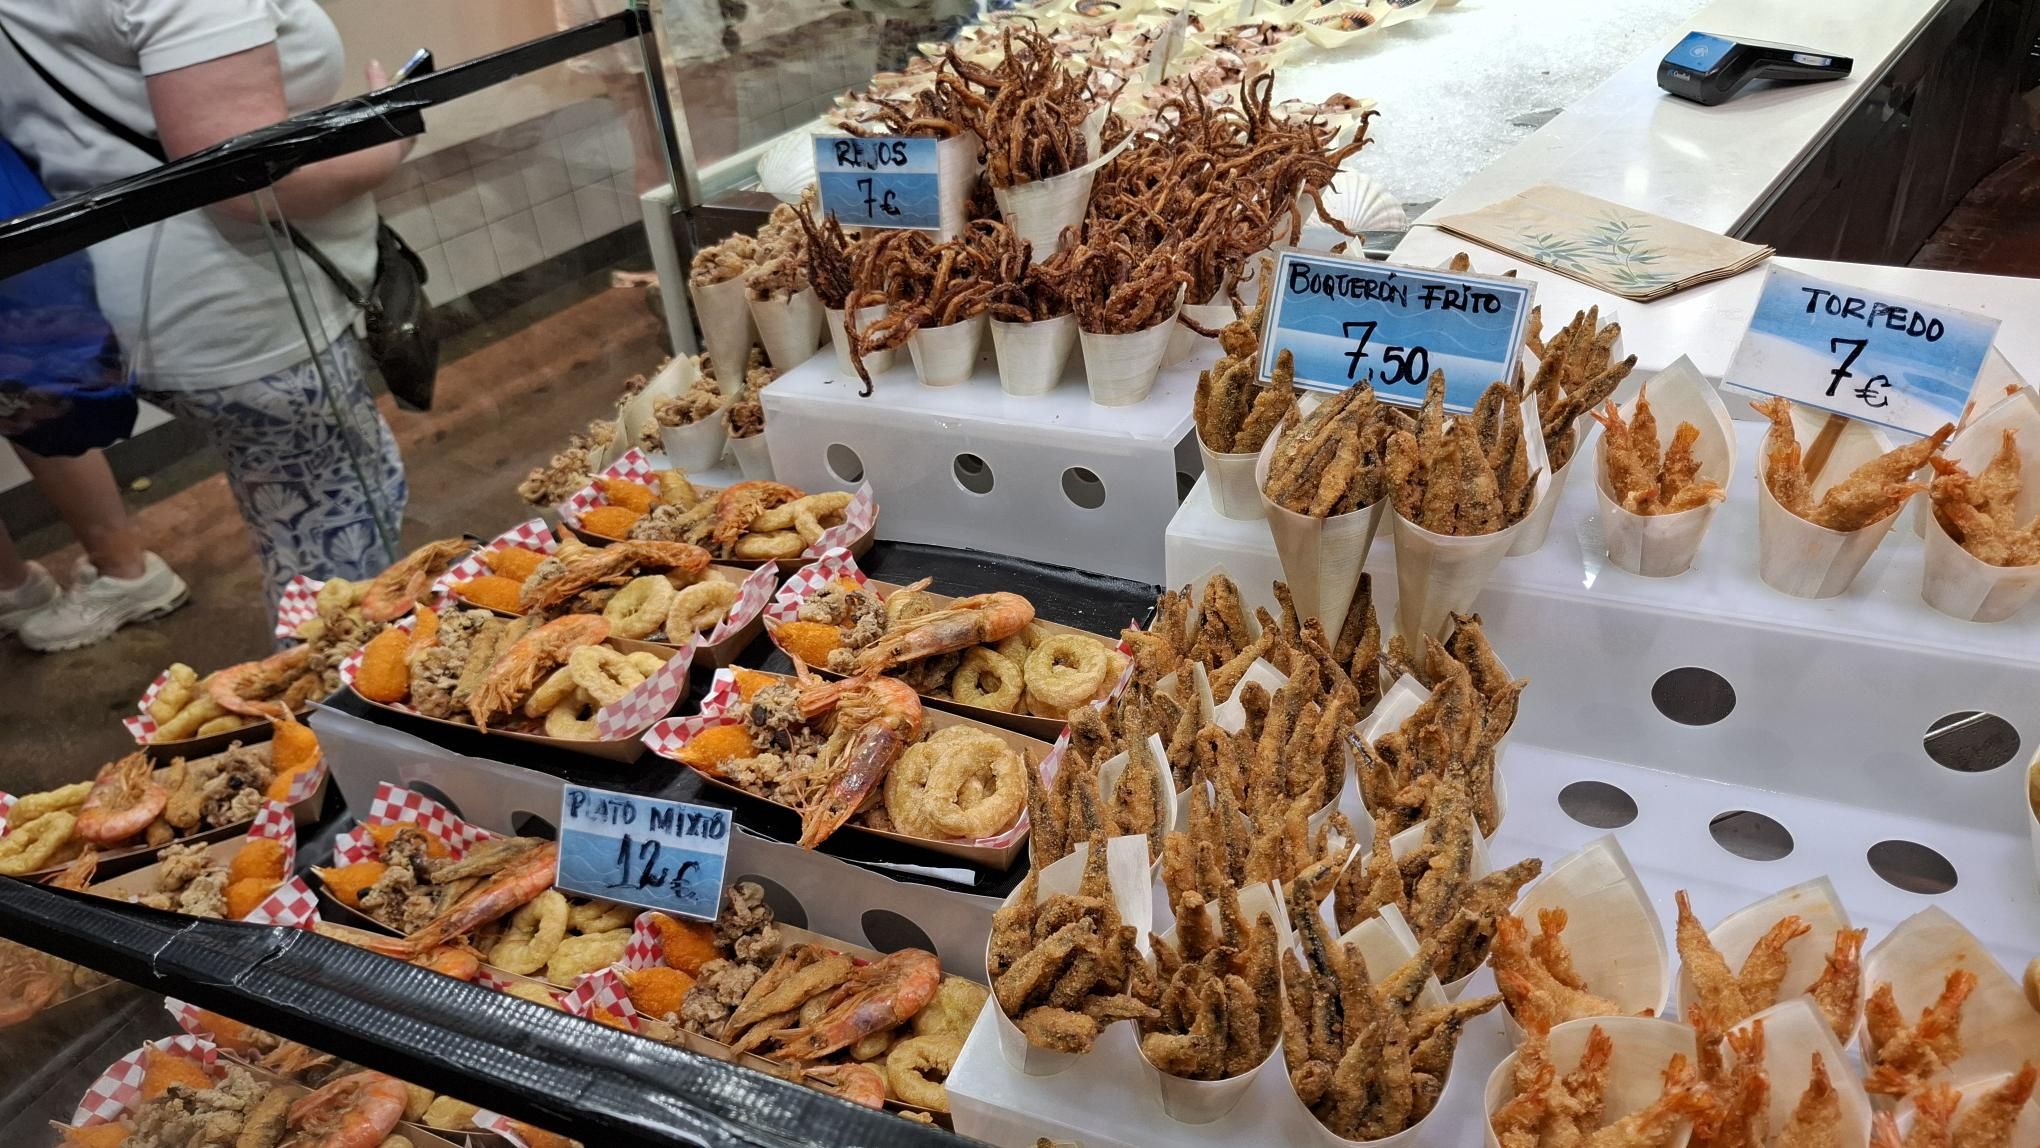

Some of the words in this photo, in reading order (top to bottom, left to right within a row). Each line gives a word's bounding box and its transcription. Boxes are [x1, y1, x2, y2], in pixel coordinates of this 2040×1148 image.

[1289, 262, 1407, 307] BOQUERÓN
[1417, 284, 1501, 314] FRITO
[1801, 287, 1945, 342] TORPEDO
[1343, 321, 1429, 386] 7,50
[650, 806, 726, 840] MIXTO
